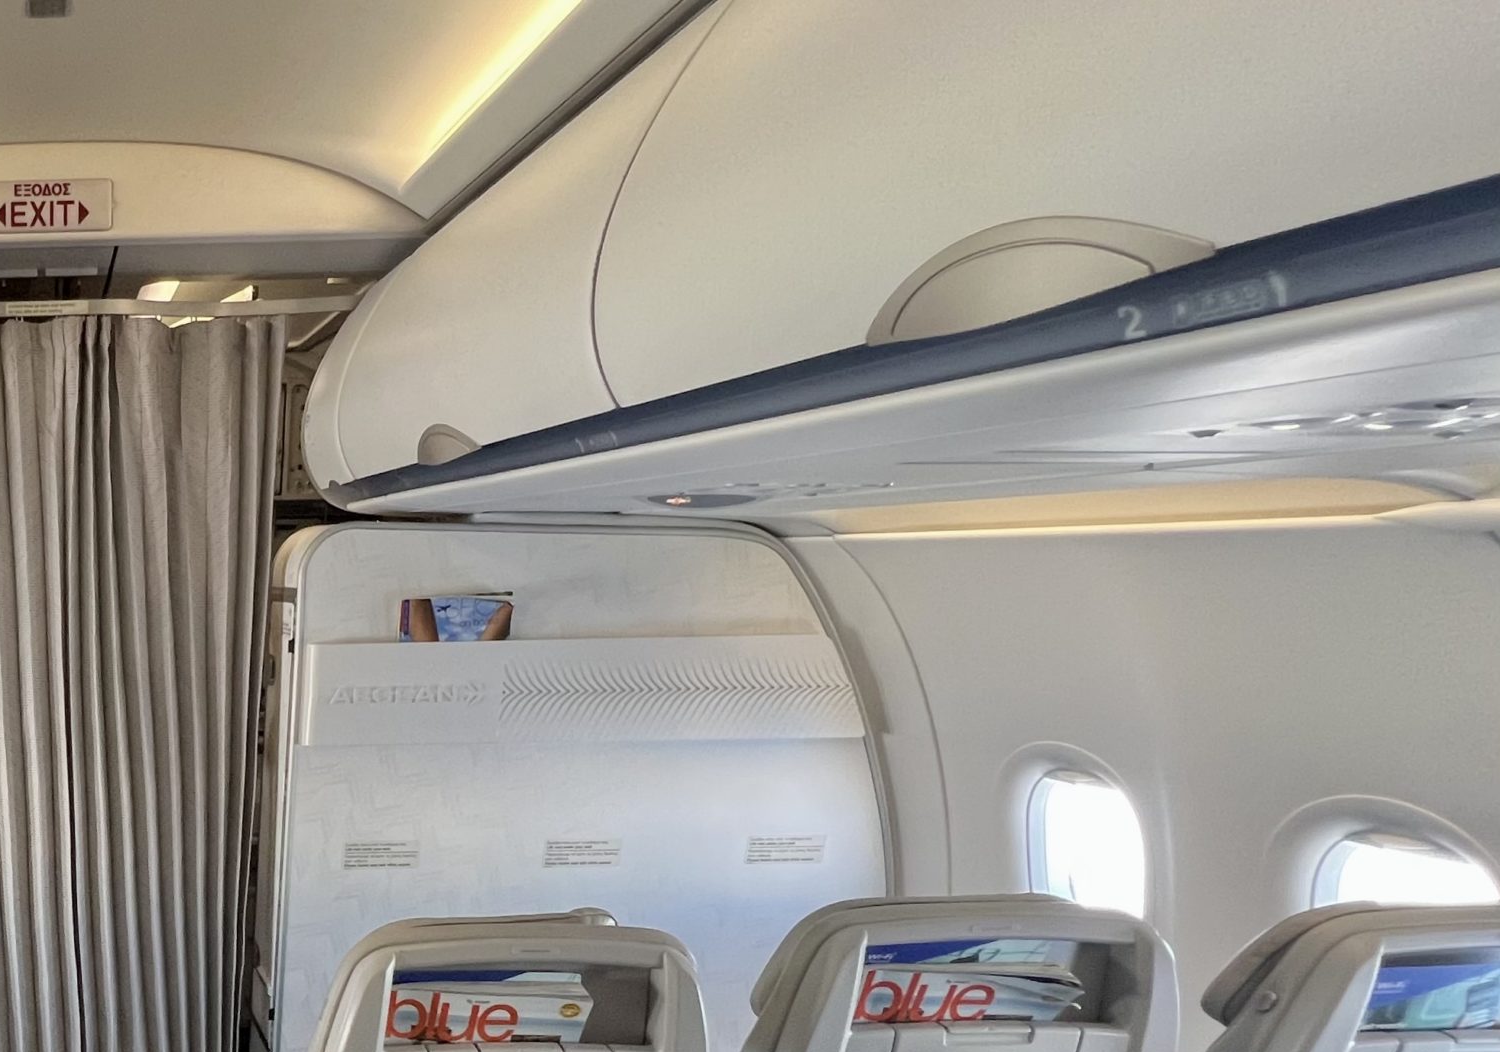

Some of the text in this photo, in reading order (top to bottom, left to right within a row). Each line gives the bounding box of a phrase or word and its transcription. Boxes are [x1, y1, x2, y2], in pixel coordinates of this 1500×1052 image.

[14, 183, 71, 197] ΕΞΟΔΟΣ
[10, 200, 75, 227] EXIT
[1117, 305, 1147, 340] 2
[853, 969, 996, 1022] blue
[385, 990, 520, 1043] blue
